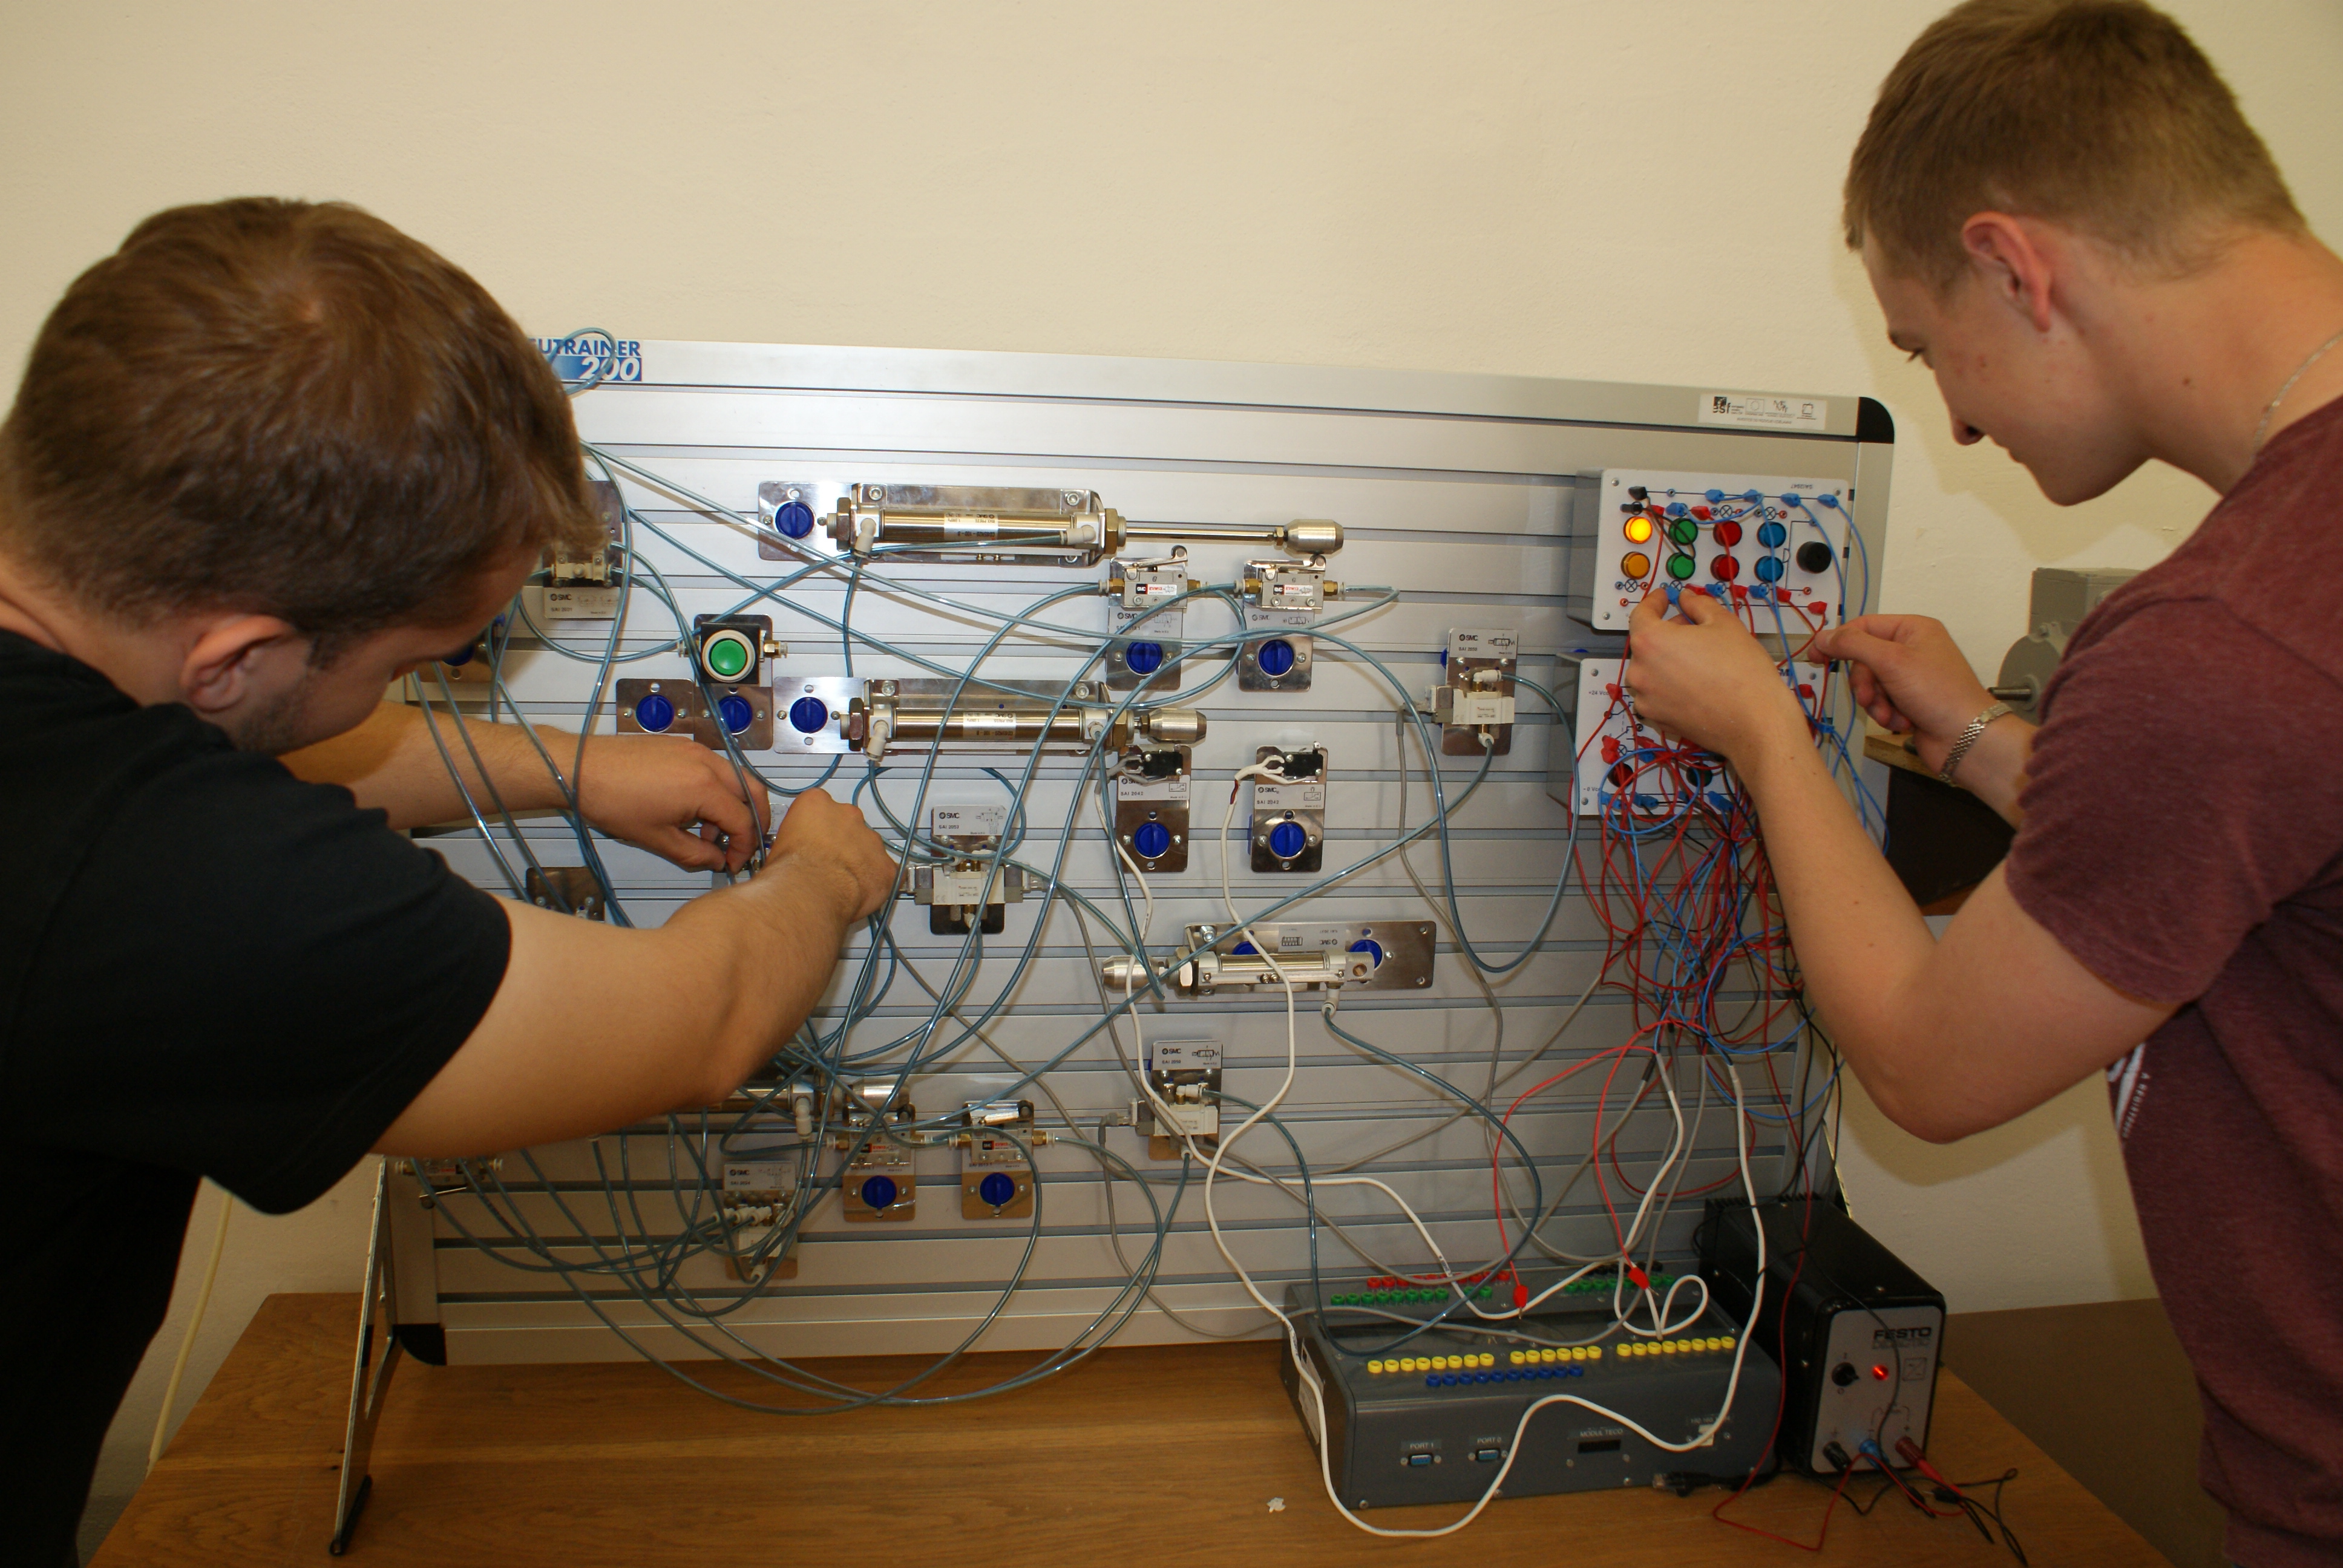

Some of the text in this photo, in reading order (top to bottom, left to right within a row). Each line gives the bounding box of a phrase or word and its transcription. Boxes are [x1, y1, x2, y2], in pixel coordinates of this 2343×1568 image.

[529, 339, 642, 356] UTRAINER
[579, 356, 640, 381] 200
[1873, 1327, 1932, 1340] FESTO
